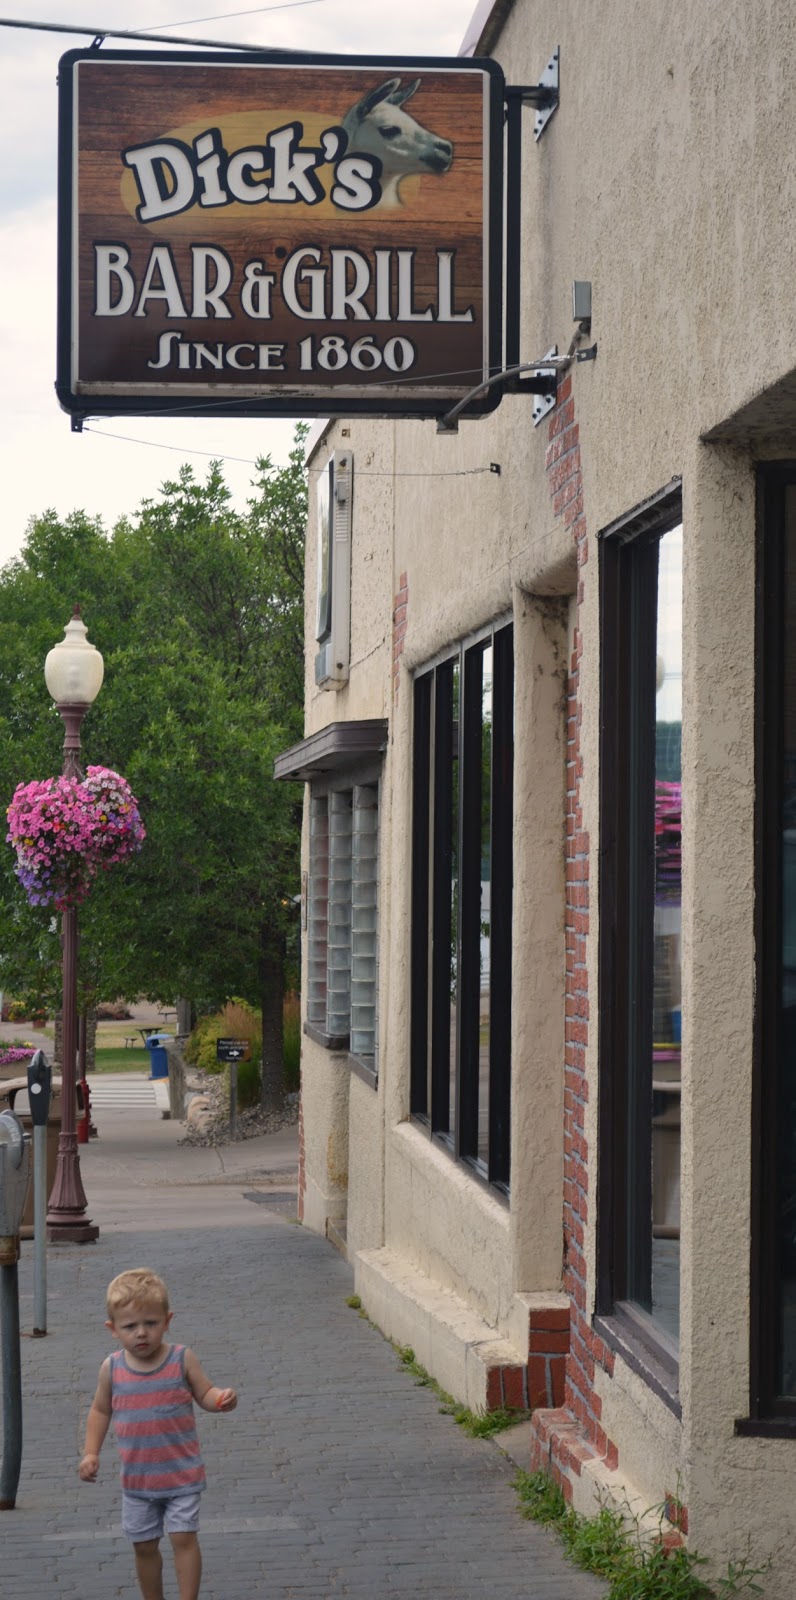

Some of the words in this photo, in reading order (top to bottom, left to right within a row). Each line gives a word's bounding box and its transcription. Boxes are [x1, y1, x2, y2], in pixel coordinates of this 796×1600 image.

[123, 122, 380, 222] Dick's
[93, 244, 233, 319] BAR
[281, 247, 474, 322] GRILL
[147, 331, 286, 370] SINCE
[299, 336, 416, 372] 1860
